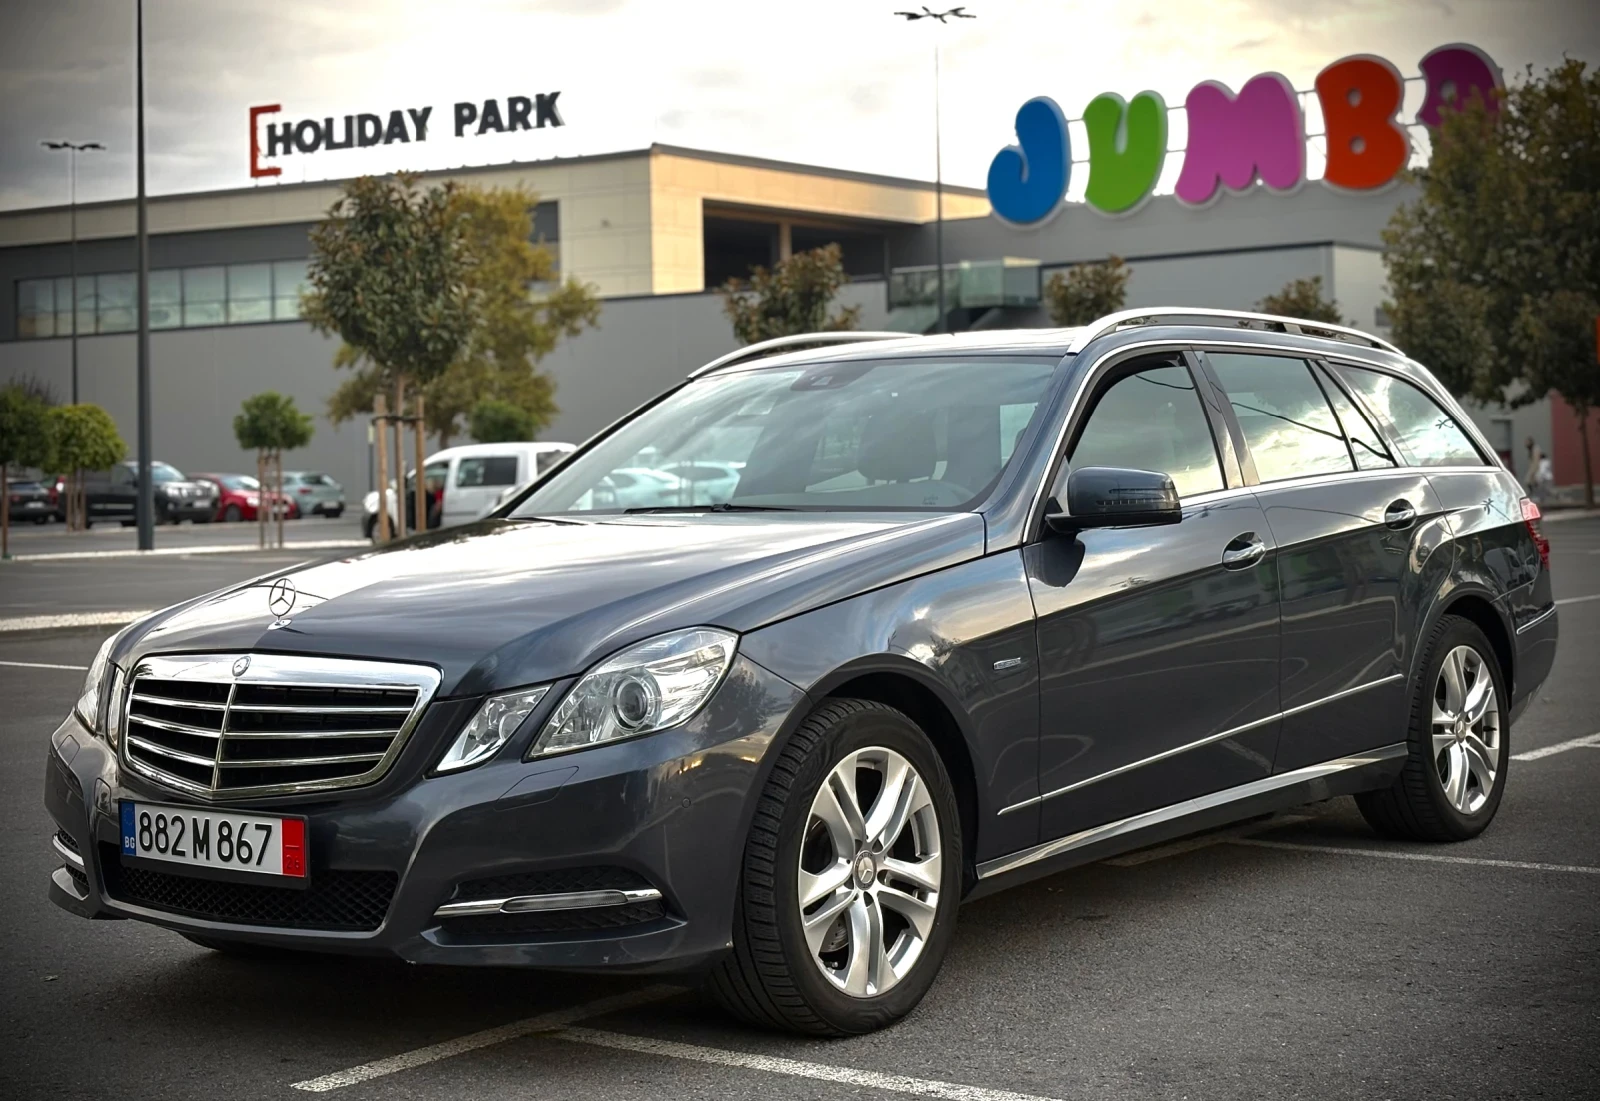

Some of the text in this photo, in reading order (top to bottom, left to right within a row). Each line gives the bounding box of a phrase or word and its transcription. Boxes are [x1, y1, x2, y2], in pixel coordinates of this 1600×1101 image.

[266, 91, 565, 157] HOLIDAY PARK
[124, 836, 136, 849] BG
